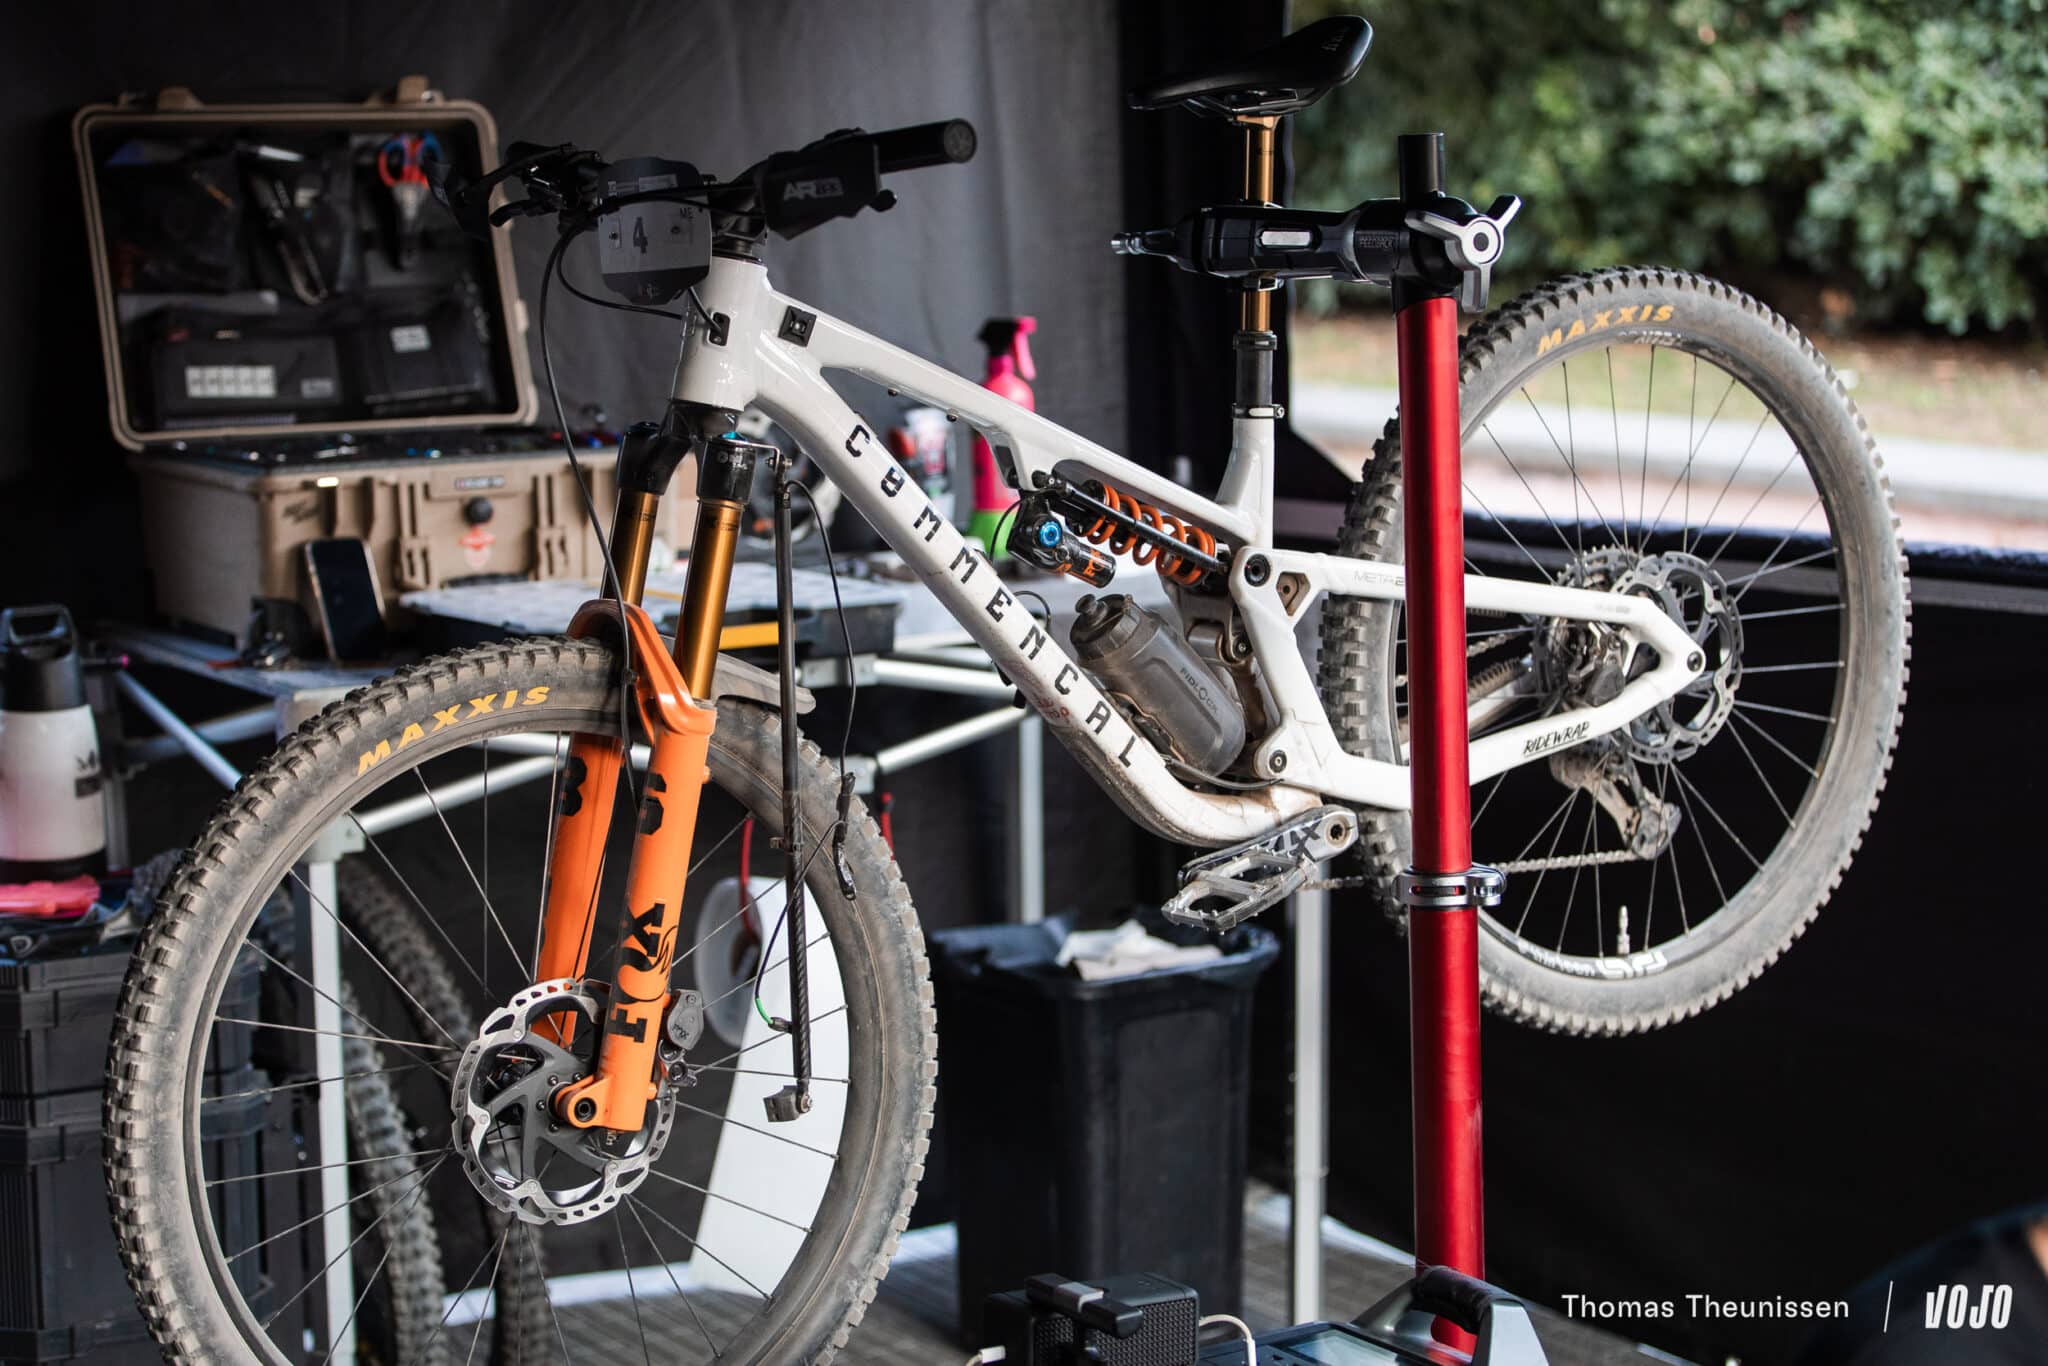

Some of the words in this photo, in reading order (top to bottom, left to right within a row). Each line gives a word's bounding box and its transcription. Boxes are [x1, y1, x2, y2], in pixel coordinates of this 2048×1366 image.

[632, 216, 648, 254] 4
[1536, 304, 1674, 357] MAXXIS
[845, 424, 1136, 768] COMMENCAL
[357, 686, 550, 776] MAXXIS
[1523, 721, 1590, 754] RIDEWRAP
[607, 903, 675, 1043] FOX
